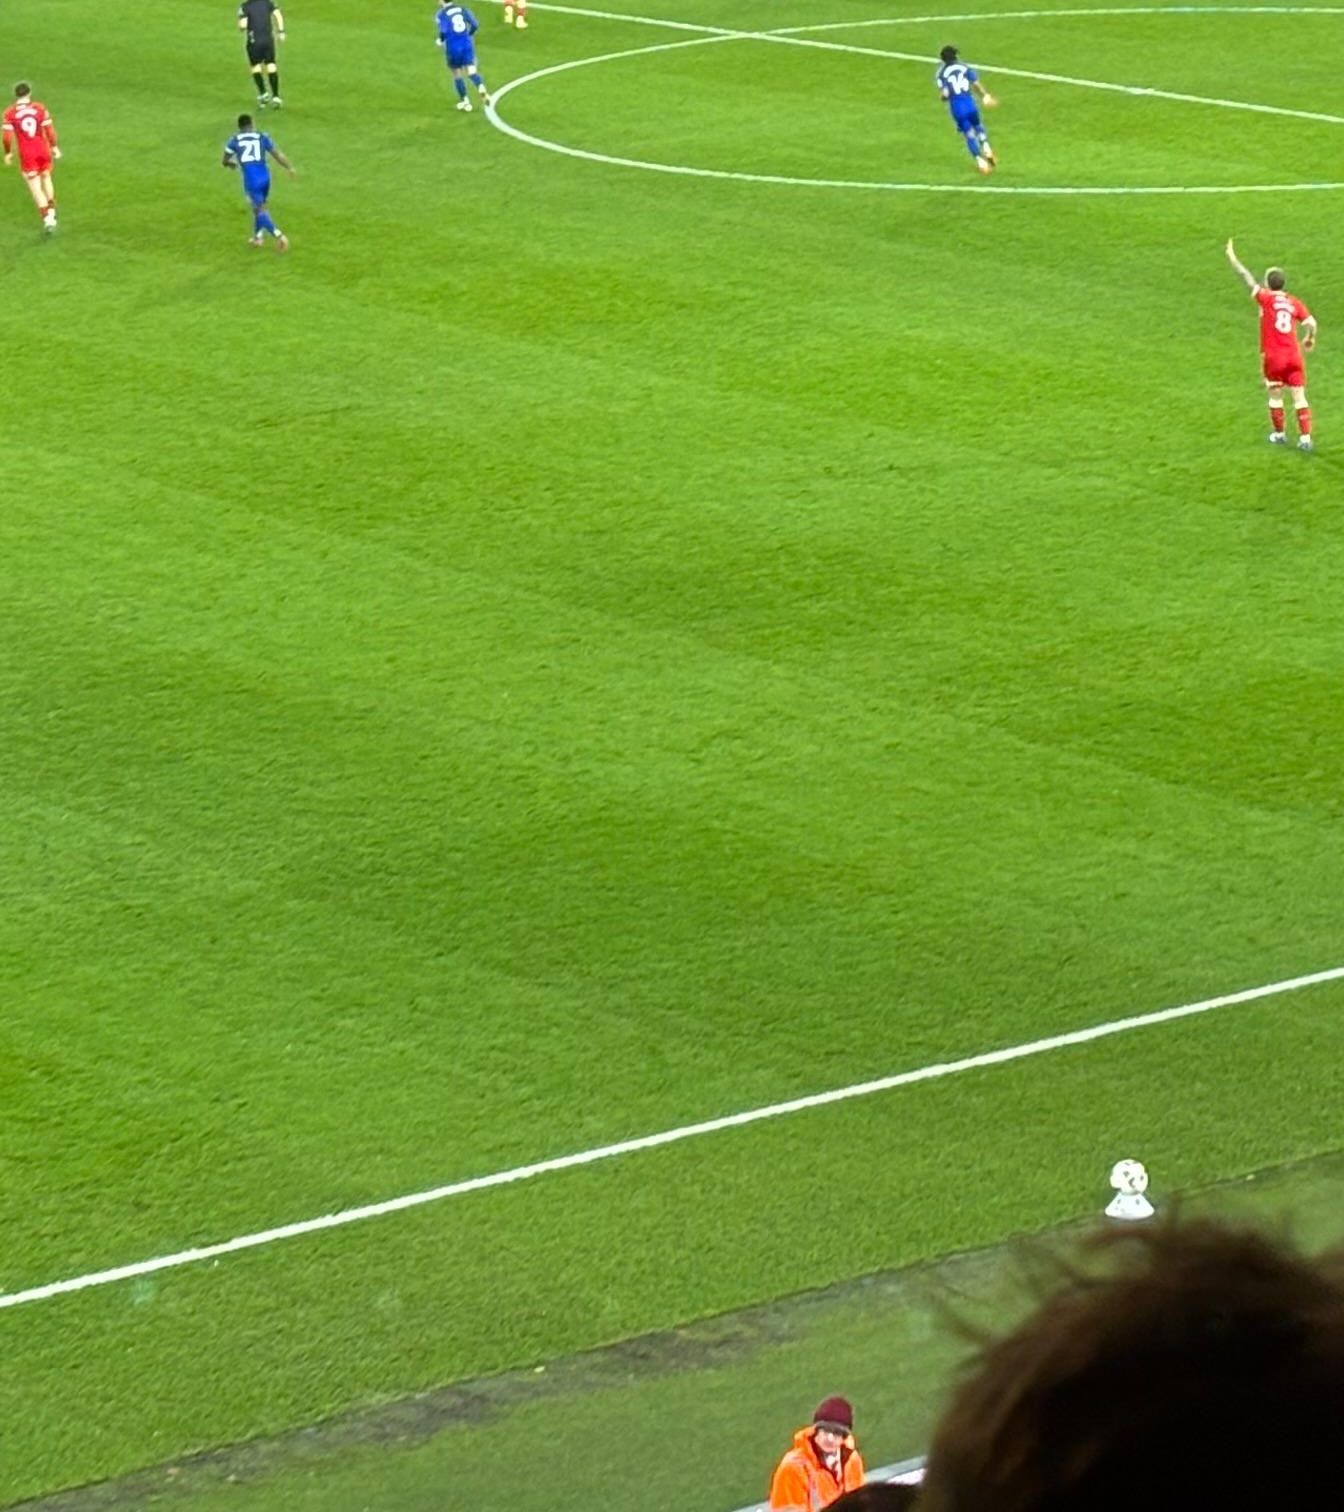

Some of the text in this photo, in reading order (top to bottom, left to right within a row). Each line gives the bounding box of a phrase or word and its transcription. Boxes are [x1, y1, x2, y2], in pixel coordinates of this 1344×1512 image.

[451, 14, 466, 33] 8
[21, 117, 37, 137] 9
[238, 139, 262, 162] 21
[1274, 310, 1292, 334] 8
